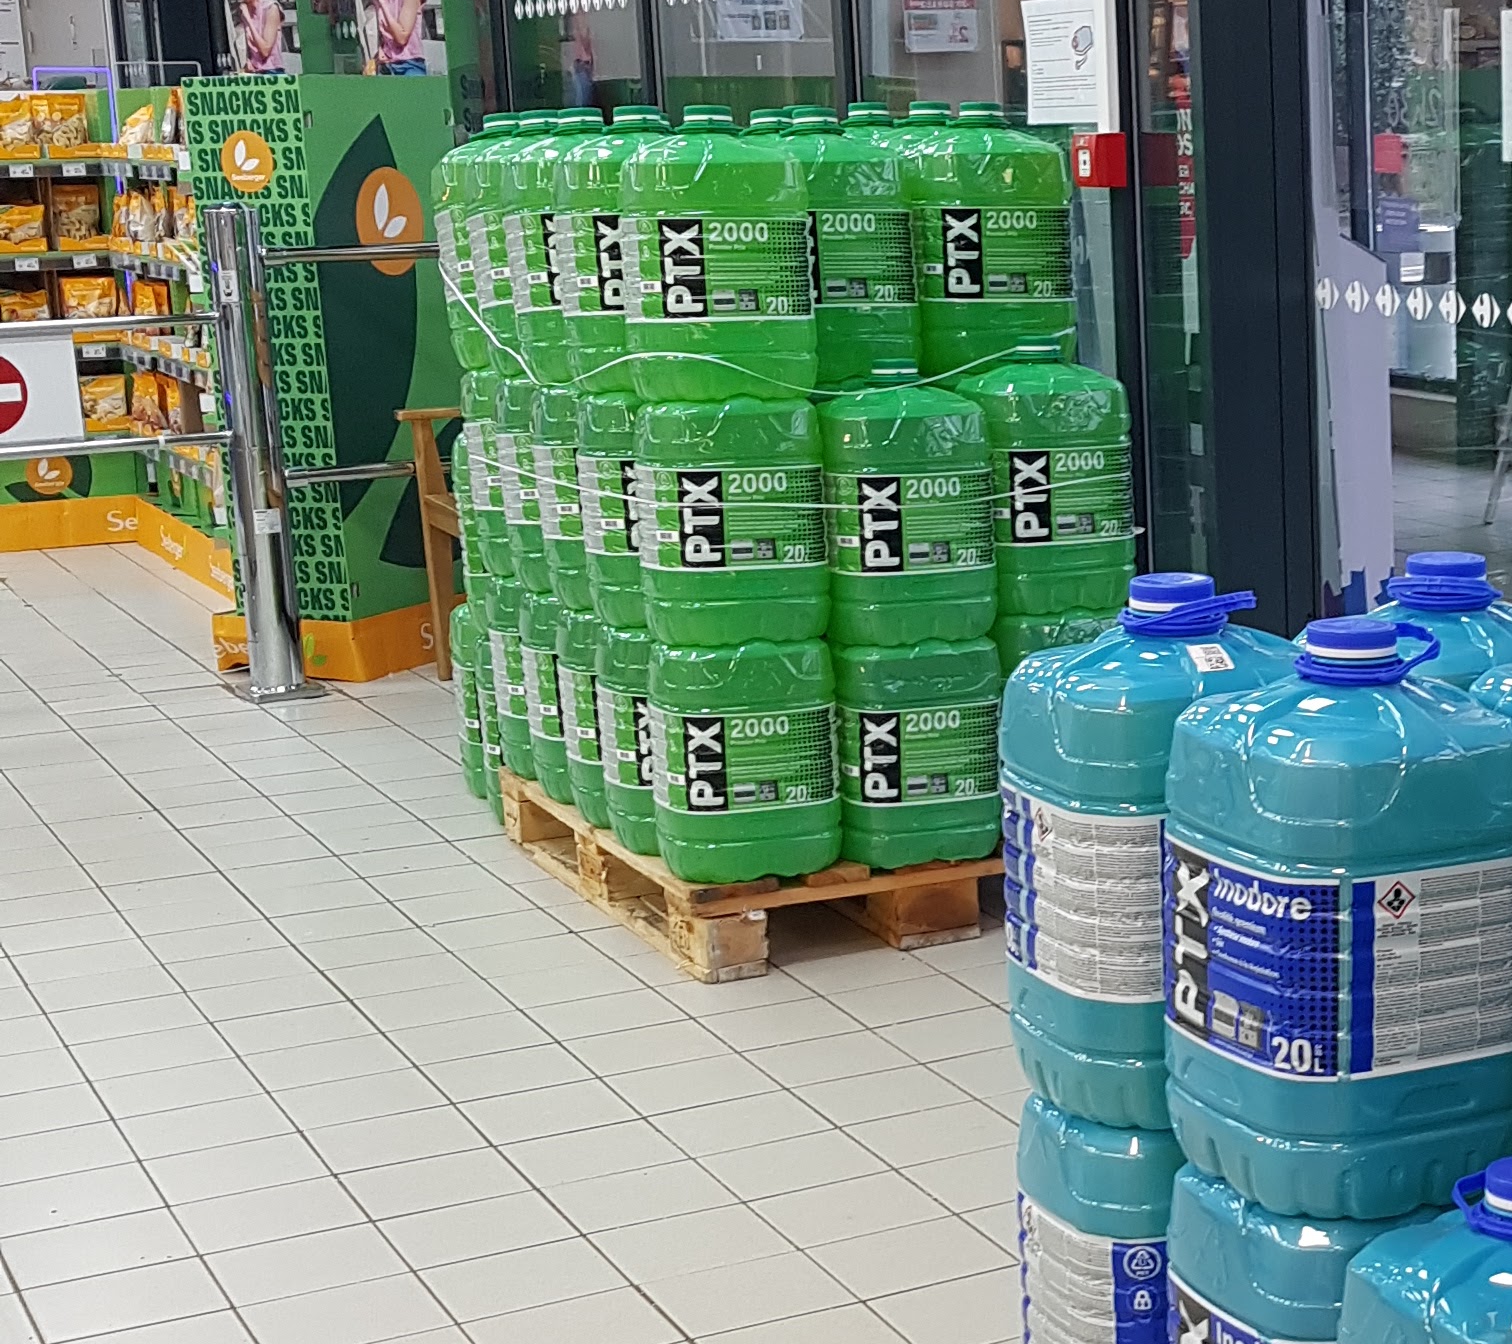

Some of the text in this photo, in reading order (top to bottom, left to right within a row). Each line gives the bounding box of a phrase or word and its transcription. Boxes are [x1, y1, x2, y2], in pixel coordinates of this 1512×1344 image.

[187, 89, 268, 116] SNACKS
[708, 222, 769, 242] 2000
[821, 213, 876, 233] 2000
[986, 211, 1038, 230] 2000
[661, 223, 704, 314] PTX
[945, 213, 981, 294] PTX
[1055, 451, 1105, 472] 2000
[728, 472, 787, 493] 2000
[905, 477, 961, 499] 2000
[1013, 455, 1050, 539] PTX
[681, 476, 723, 563] PTX
[861, 482, 900, 567] PTX
[730, 716, 790, 739] 2000
[905, 710, 961, 732] 2000
[686, 721, 725, 806] PTX
[863, 717, 899, 803] PTX
[1213, 868, 1313, 921] Inodore
[1173, 861, 1210, 1028] PTX
